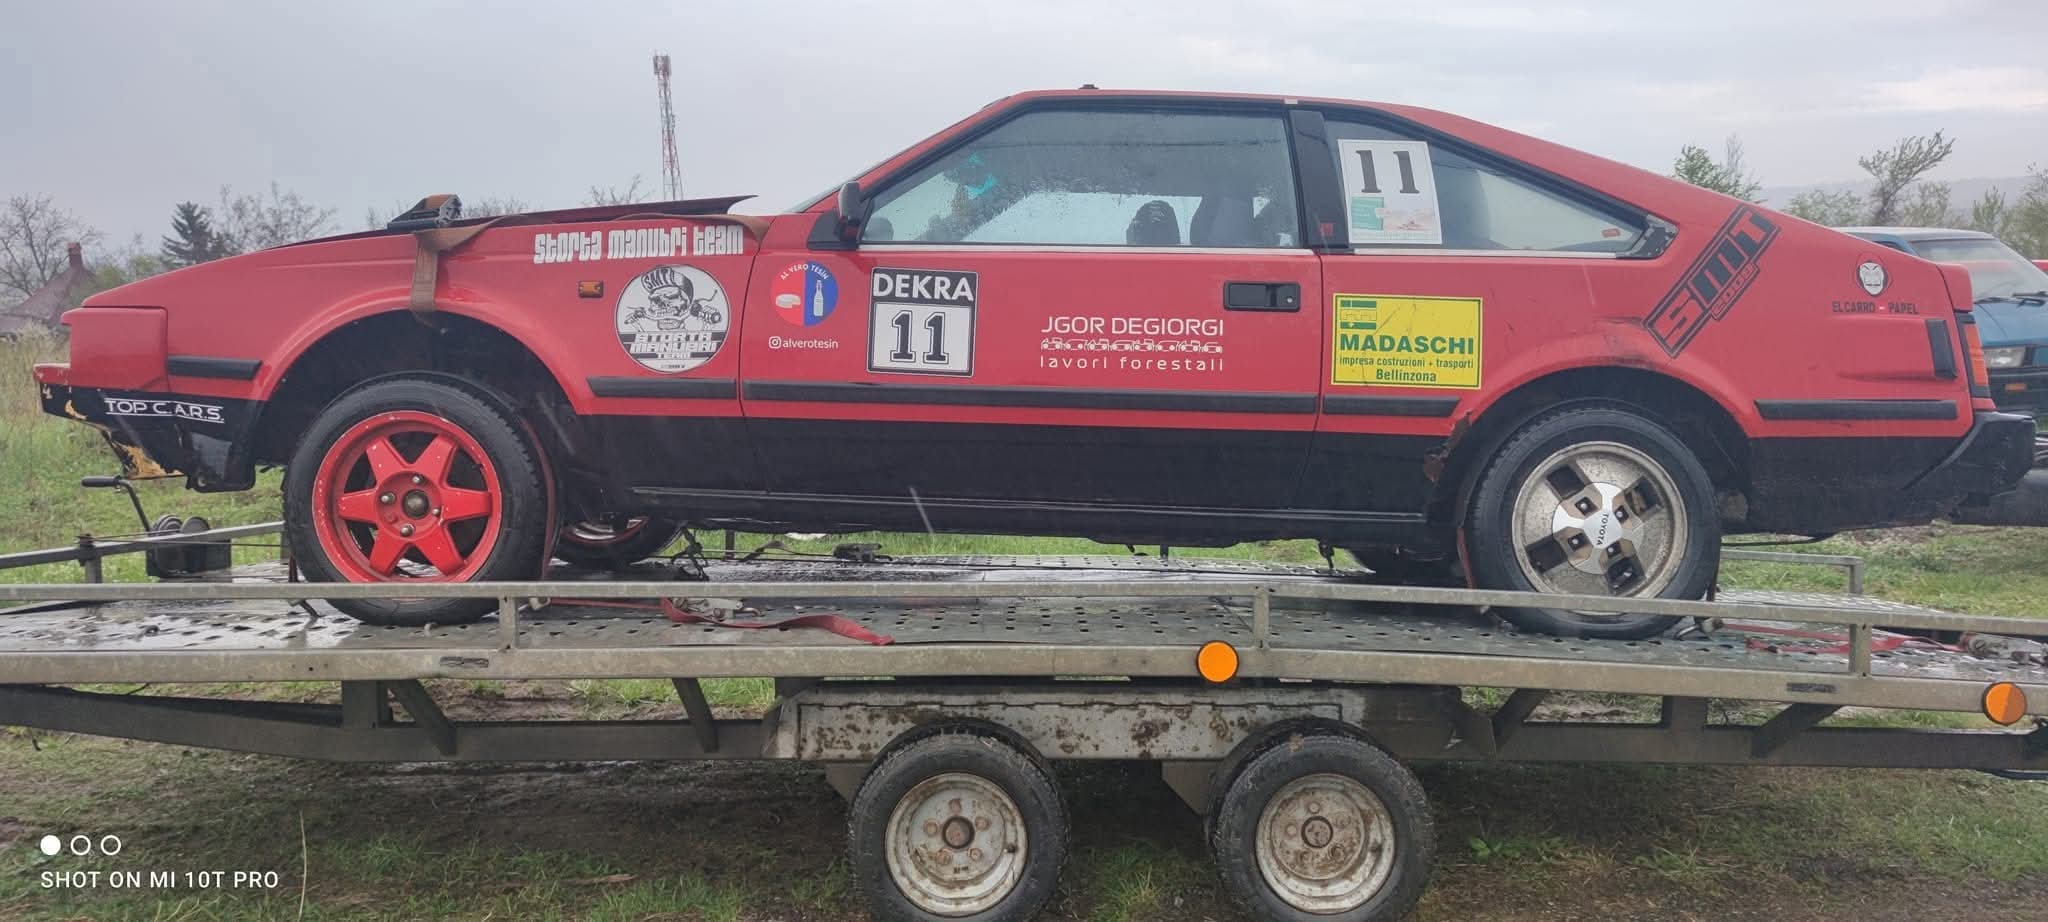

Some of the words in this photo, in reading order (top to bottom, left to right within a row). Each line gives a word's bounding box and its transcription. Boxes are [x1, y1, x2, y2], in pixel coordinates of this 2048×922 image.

[1355, 149, 1420, 194] 11
[788, 263, 809, 273] VERO
[872, 273, 974, 302] DEKRA
[1844, 302, 1876, 313] CARRO
[1888, 302, 1919, 315] PAPEL
[1111, 318, 1224, 336] DEGIORGI
[782, 338, 839, 349] alverotesin
[890, 310, 950, 364] 11
[1340, 333, 1474, 355] MADASCHI
[1040, 356, 1107, 369] lavori
[1120, 357, 1223, 371] forestali
[1340, 355, 1375, 367] impresa
[1376, 357, 1426, 368] costruzioni
[1436, 358, 1474, 370] trasporti
[1376, 368, 1437, 382] Bellinzona
[104, 400, 148, 414] TOP
[1596, 513, 1609, 545] TOYOTA
